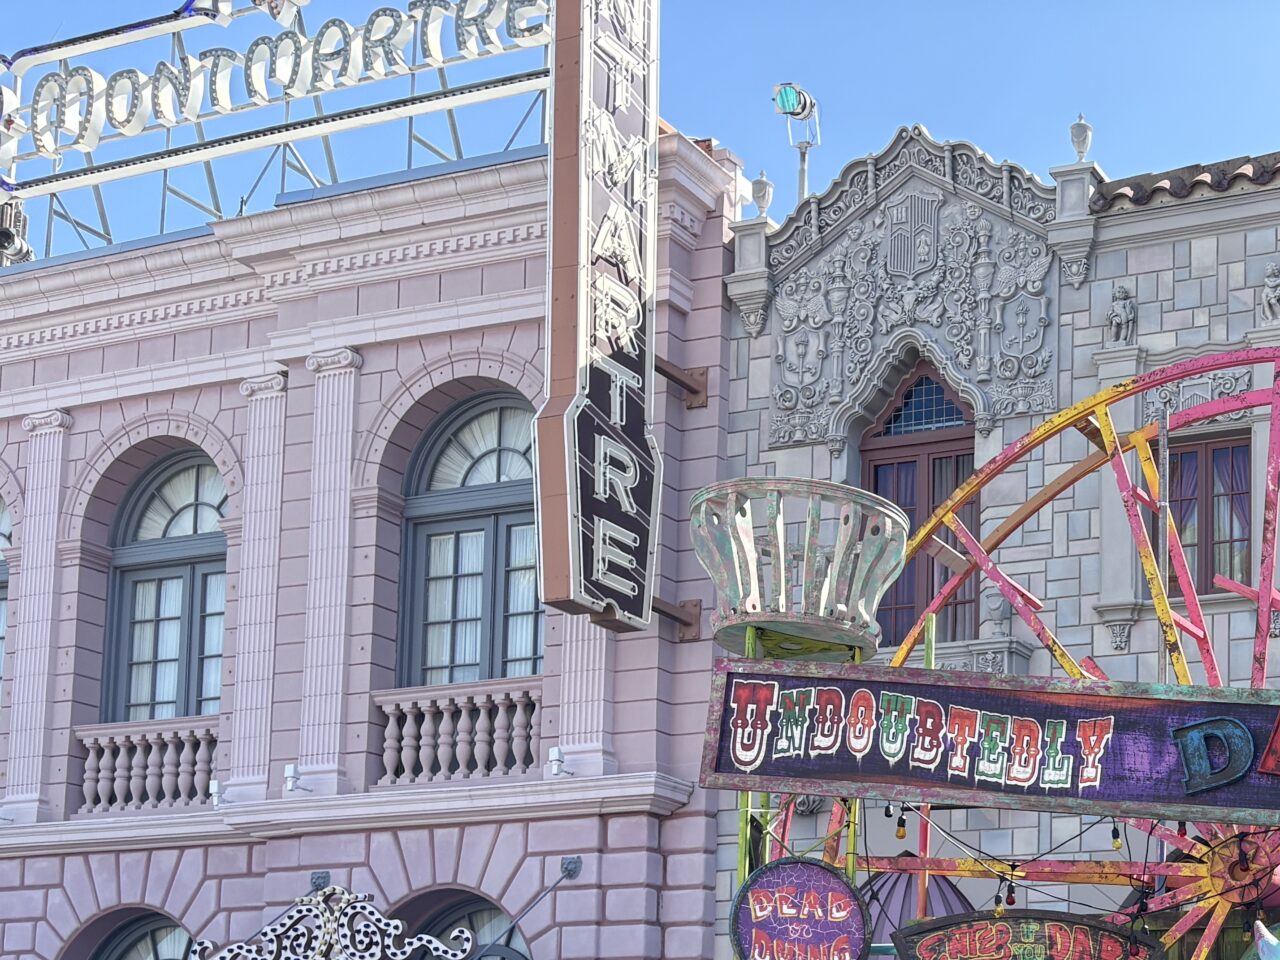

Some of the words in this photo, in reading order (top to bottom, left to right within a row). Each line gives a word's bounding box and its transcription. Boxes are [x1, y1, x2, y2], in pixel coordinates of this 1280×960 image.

[31, 0, 548, 158] MONTMARTRE
[730, 679, 1114, 792] UNDOUBTEDLY
[748, 886, 853, 922] DEAD
[1020, 922, 1040, 943] IF
